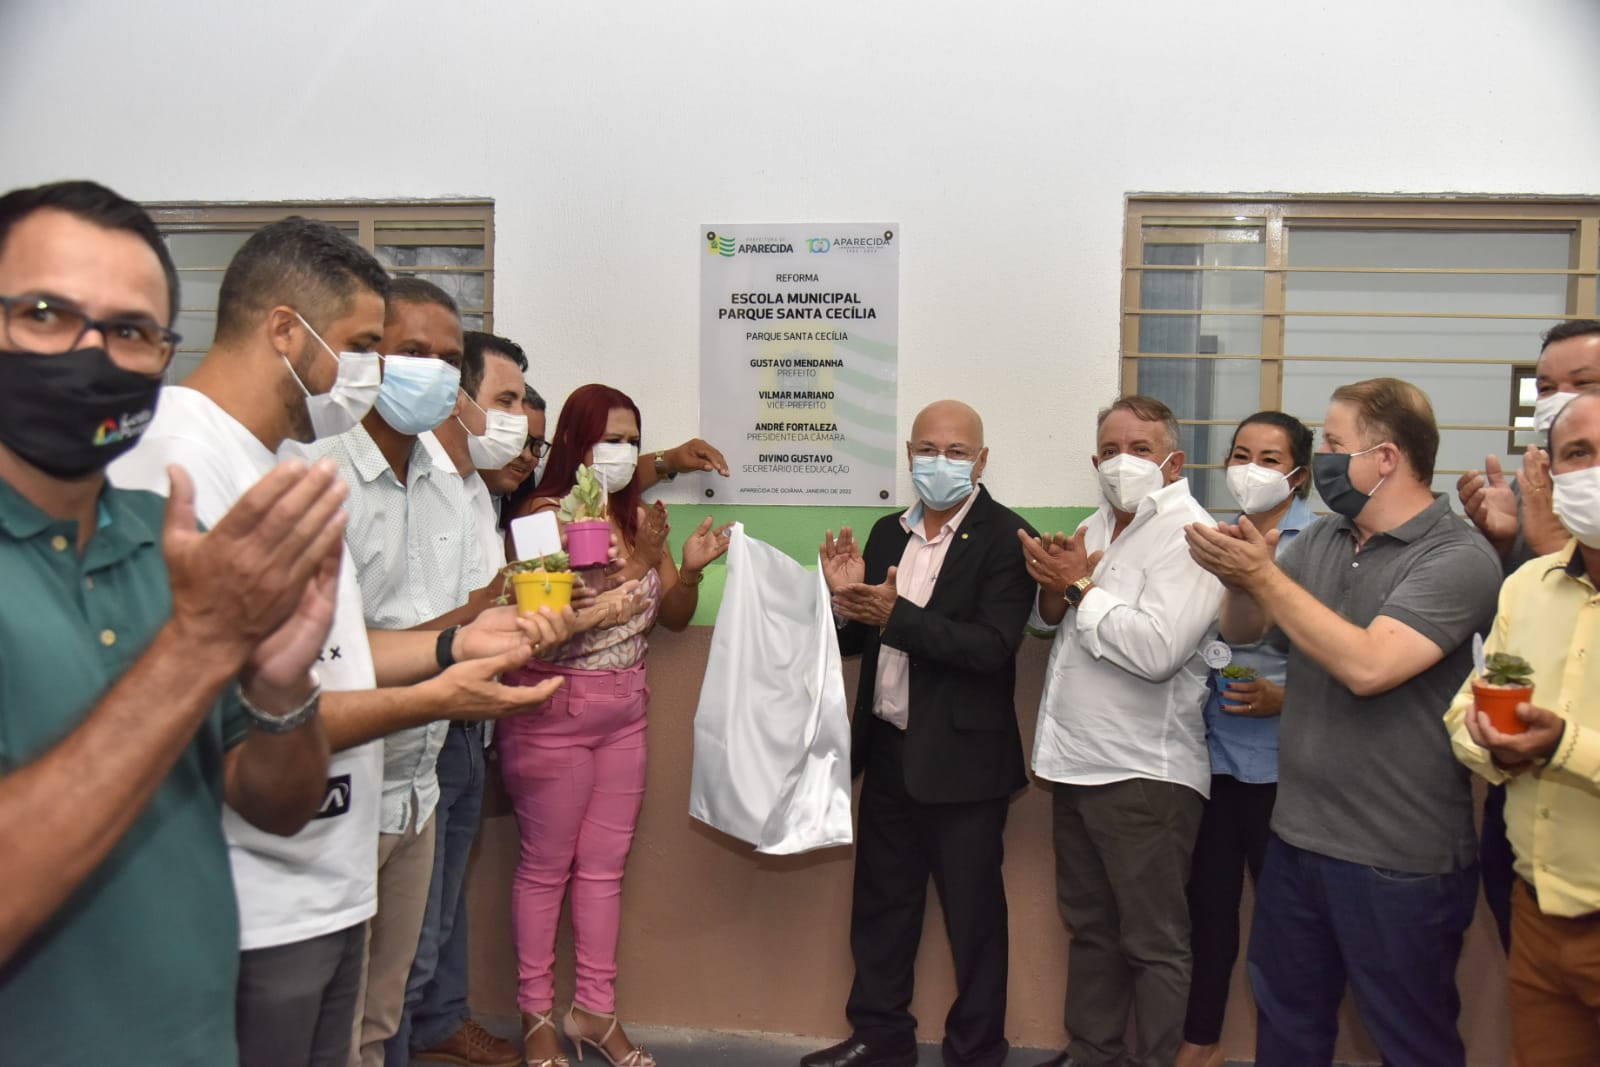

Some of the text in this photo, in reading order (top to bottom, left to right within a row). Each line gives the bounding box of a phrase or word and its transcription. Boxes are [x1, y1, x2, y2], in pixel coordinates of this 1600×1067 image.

[833, 238, 890, 246] APARECIDA
[738, 244, 794, 254] APARECIDA
[776, 274, 819, 282] REFORMA
[731, 292, 861, 304] ESCOLA MUNICIPAL
[718, 306, 876, 320] PARQUE SANTA CECÍLIA
[746, 330, 848, 341] PARQUE SANTA CECÍLIA
[750, 359, 844, 368] GUSTAVO MENDANHA
[777, 369, 816, 377] PREFEITO
[758, 391, 834, 399] VILMAR MARIANO
[755, 422, 837, 431] ANDRÉ FORTALEZA
[747, 432, 845, 441] PRESIDENTE DA CÂMARA
[759, 454, 832, 463] DIVINO GUSTAVO
[742, 464, 850, 475] SECRETÁRIO DE EDUCAÇÃO
